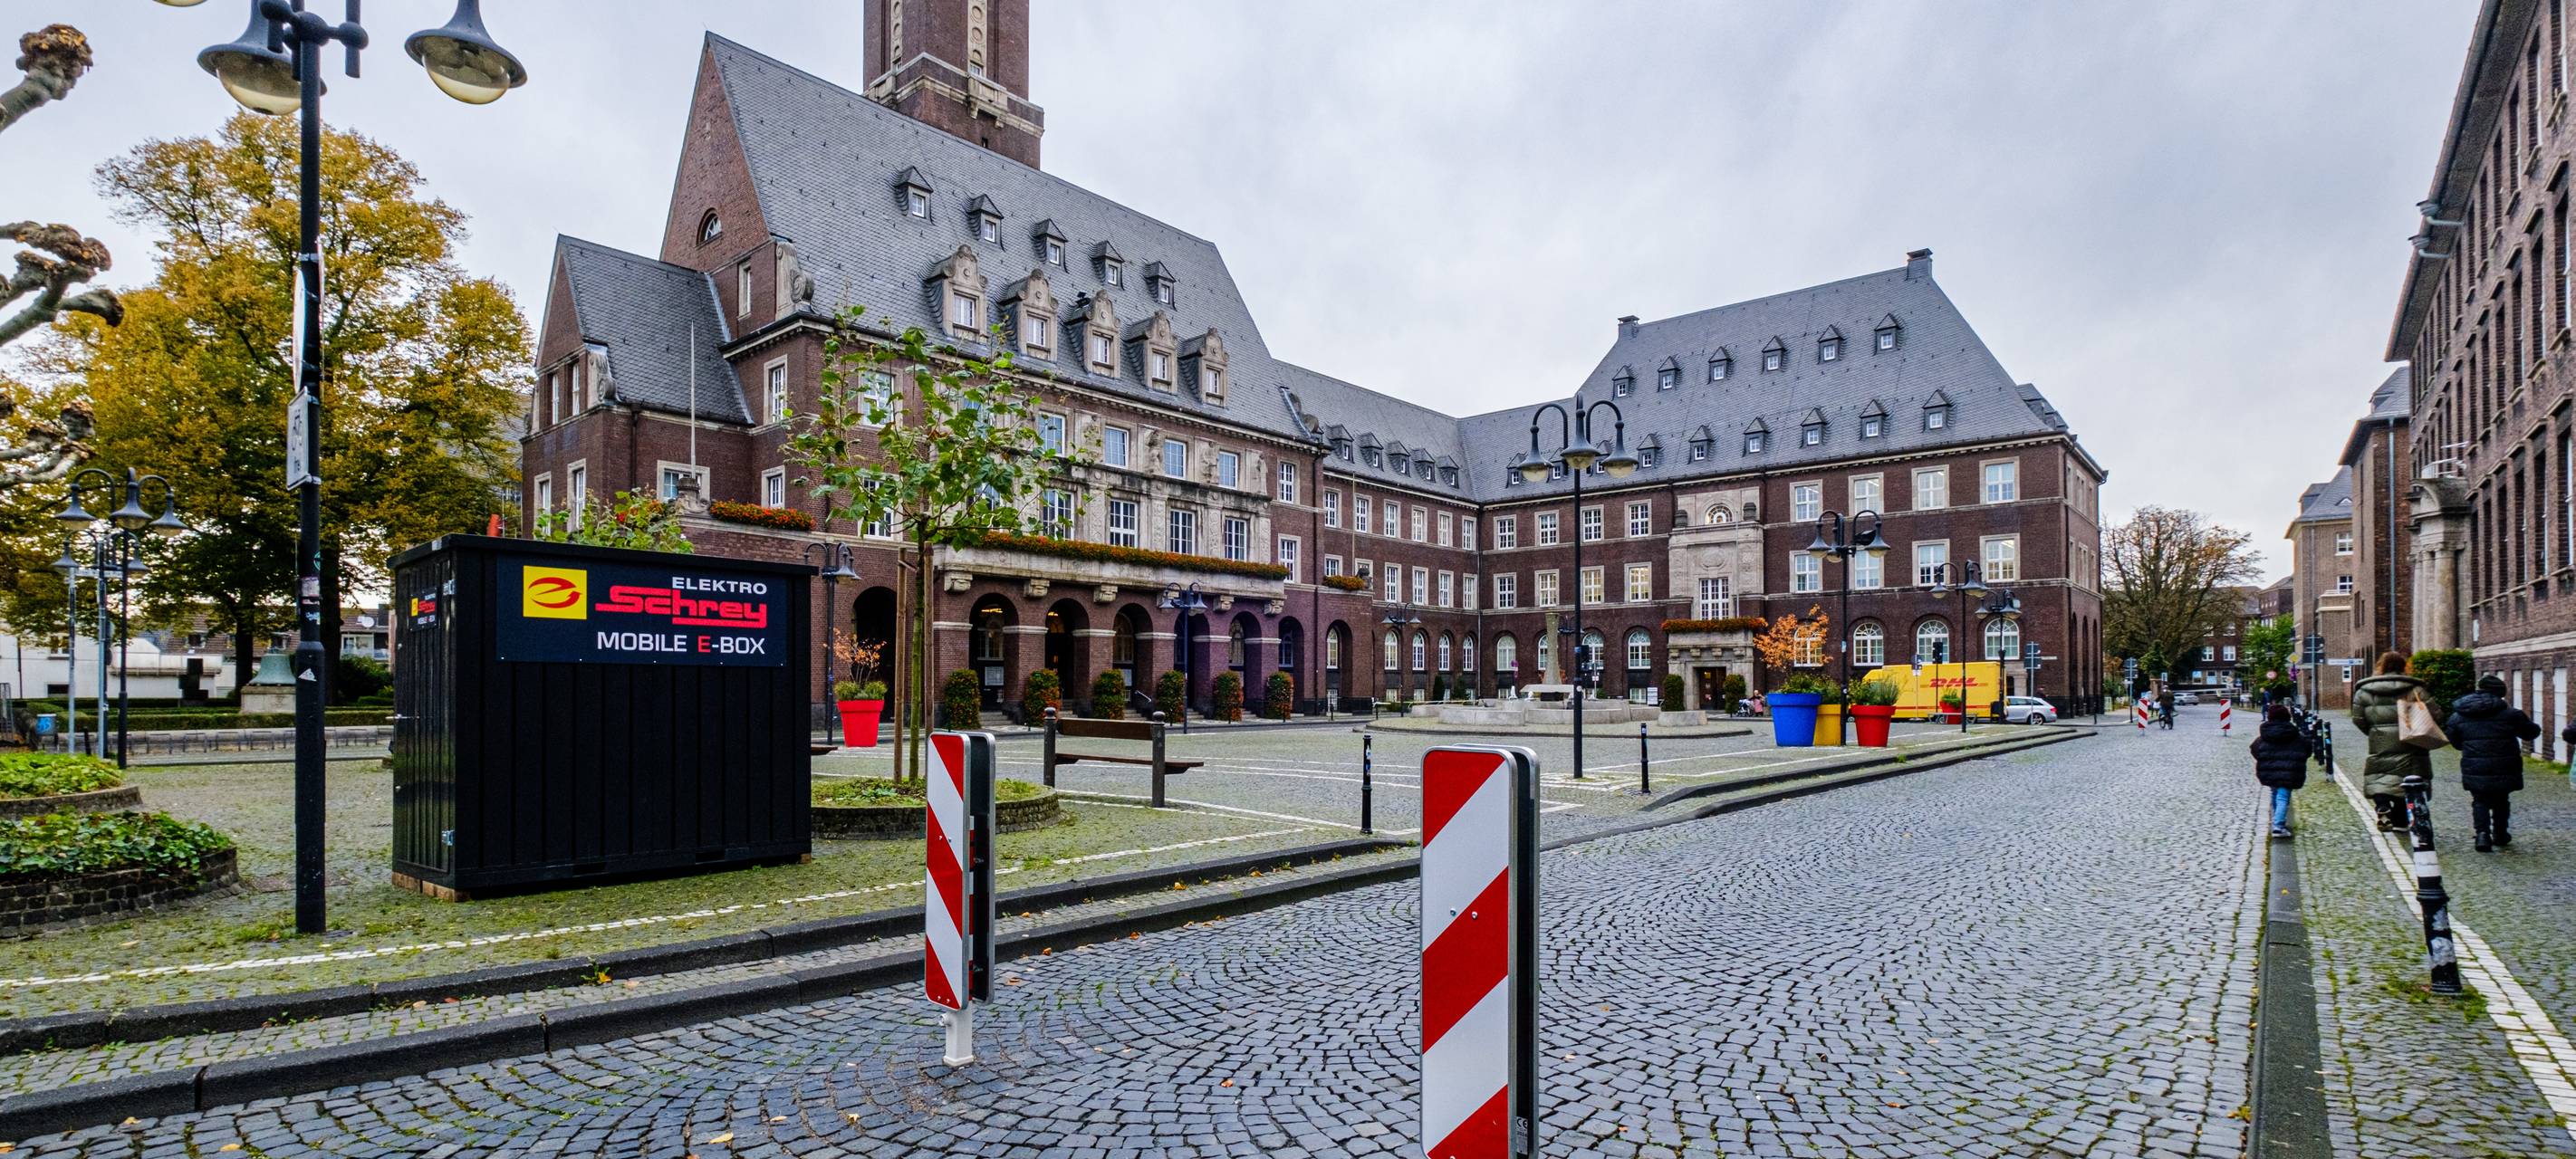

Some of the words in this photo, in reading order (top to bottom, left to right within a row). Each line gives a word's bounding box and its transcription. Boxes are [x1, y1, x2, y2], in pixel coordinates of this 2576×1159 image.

[671, 576, 767, 596] ELEKTRO
[594, 585, 767, 628] Schrey
[597, 631, 687, 652] MOBILE
[697, 636, 765, 655] E-BOX
[1929, 677, 1978, 688] DHL
